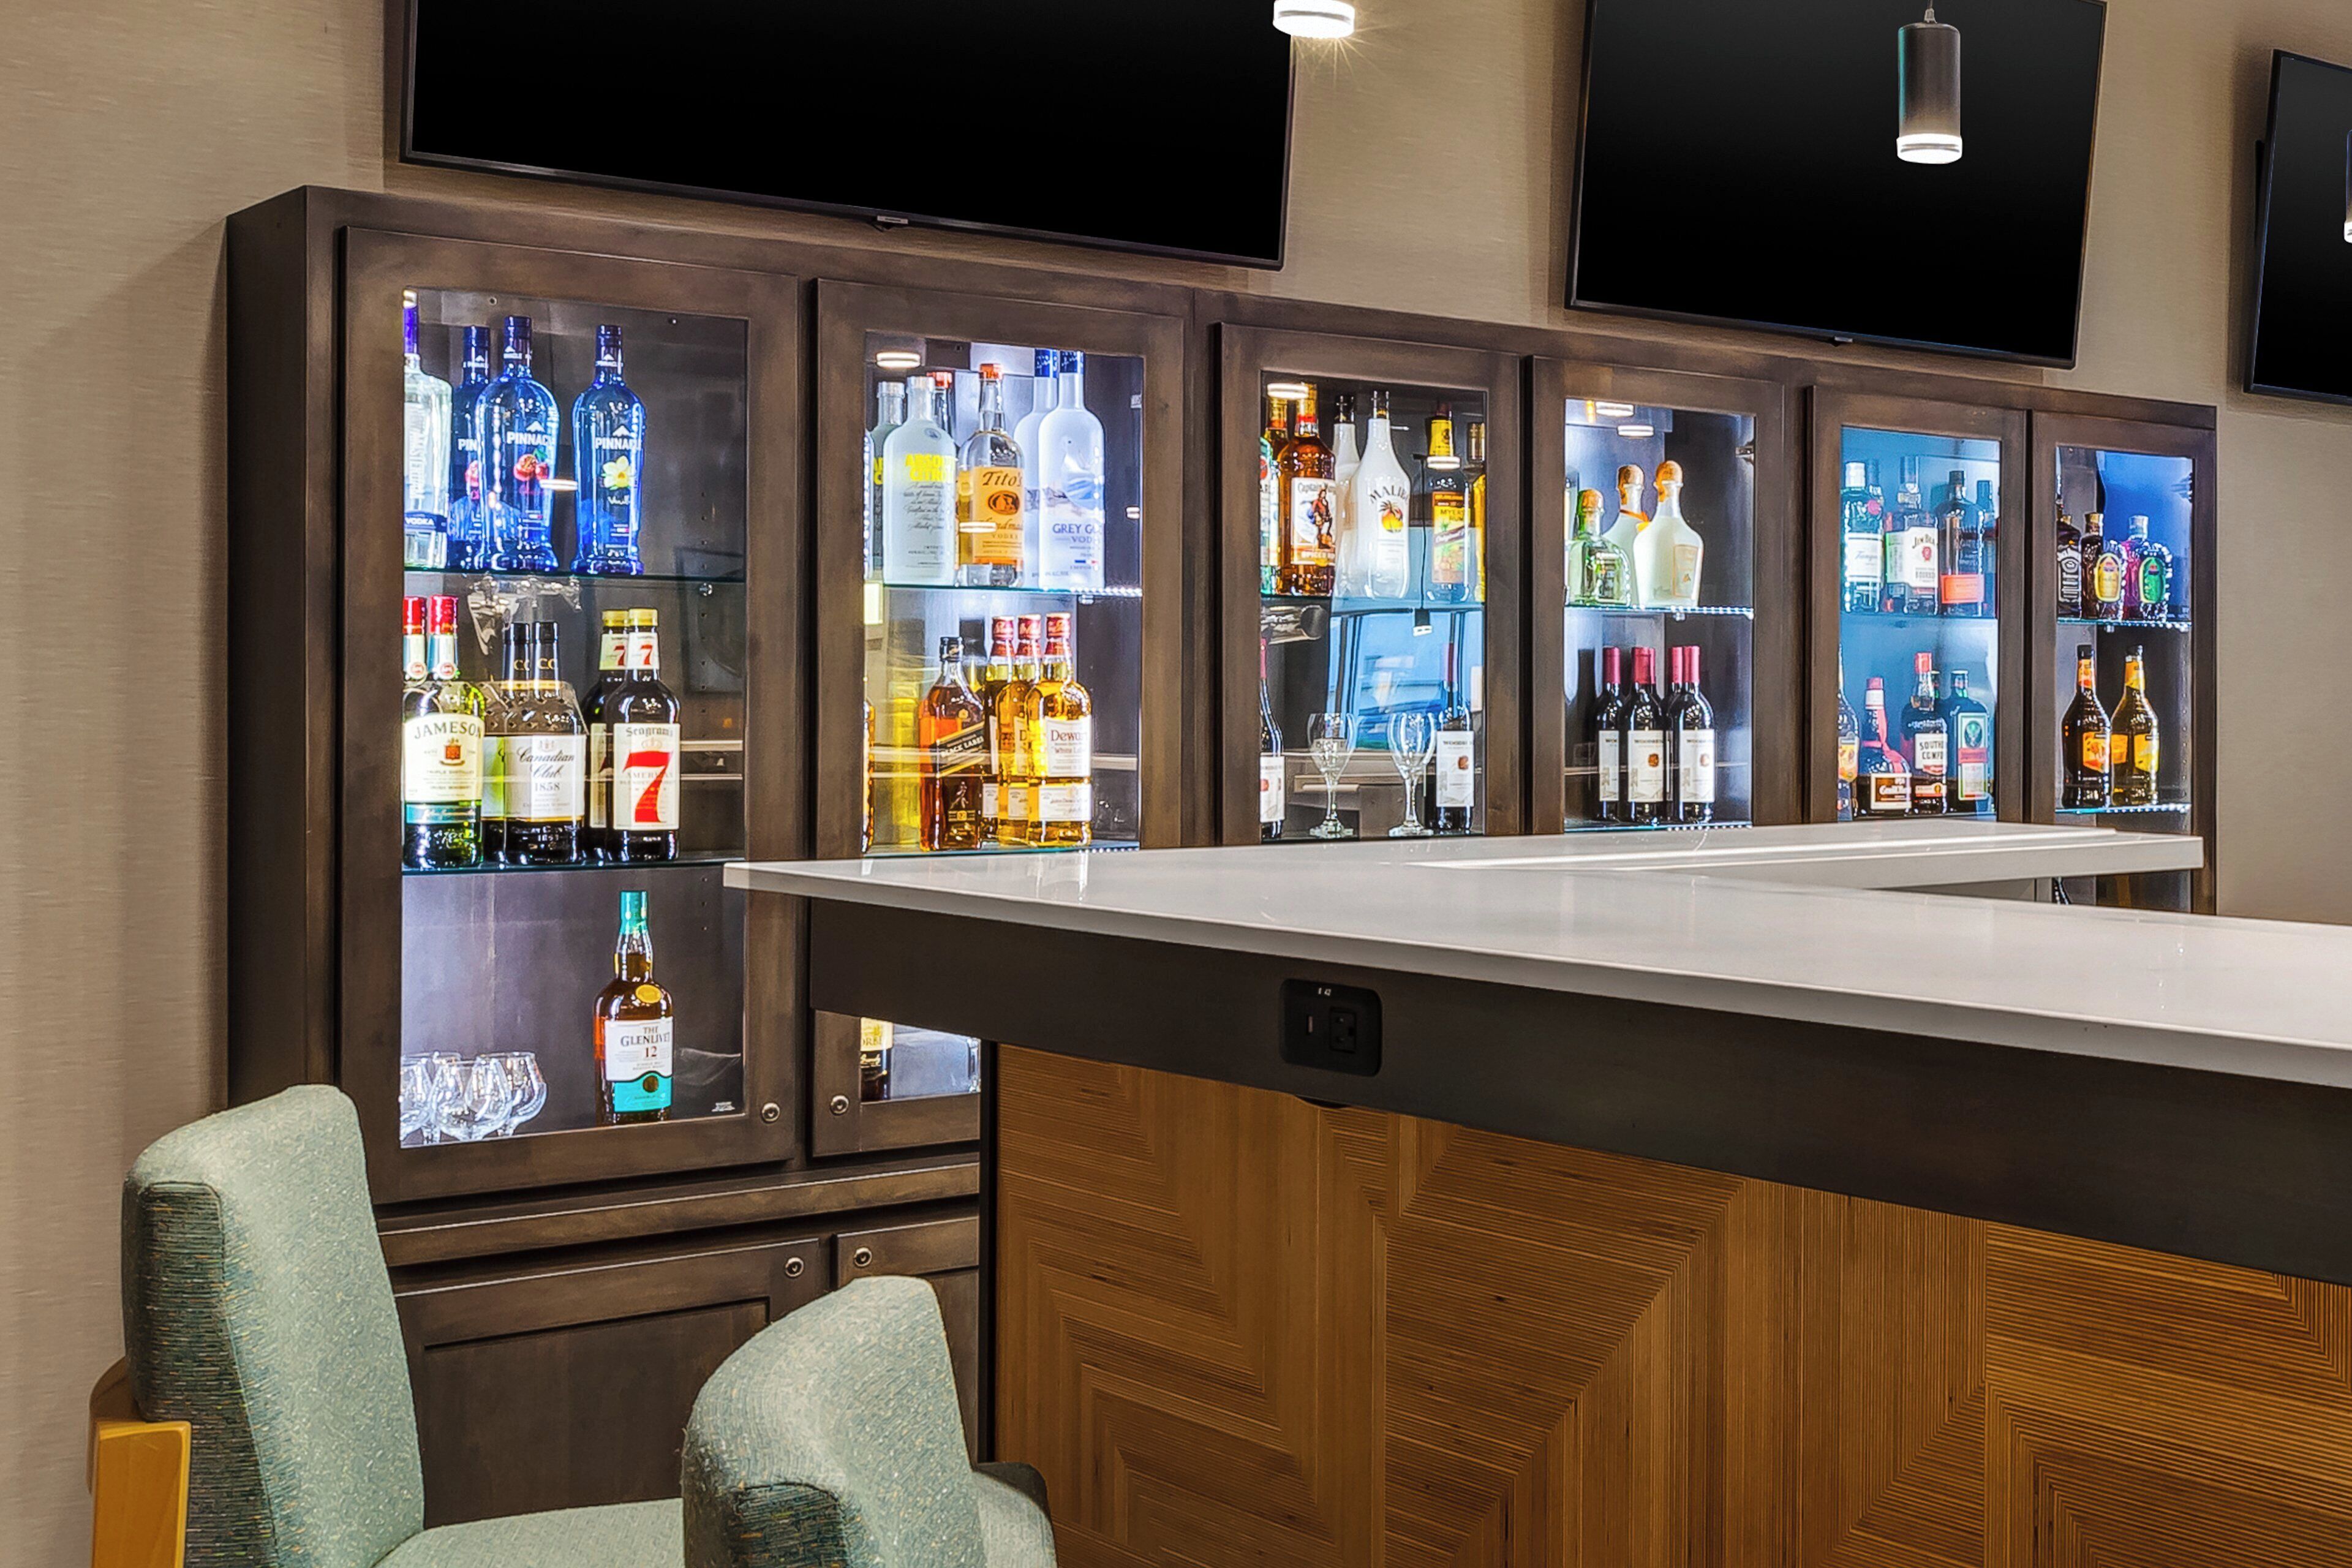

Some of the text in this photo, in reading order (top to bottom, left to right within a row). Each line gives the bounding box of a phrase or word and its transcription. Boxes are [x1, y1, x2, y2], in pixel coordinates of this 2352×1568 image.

[982, 470, 1023, 487] Tito's
[1052, 523, 1082, 534] GREY
[614, 645, 625, 666] 7
[640, 644, 654, 665] 7
[516, 745, 575, 763] Canadian
[535, 782, 560, 791] 1858
[622, 750, 674, 823] 7
[643, 1025, 658, 1035] THE
[645, 1046, 657, 1058] 12
